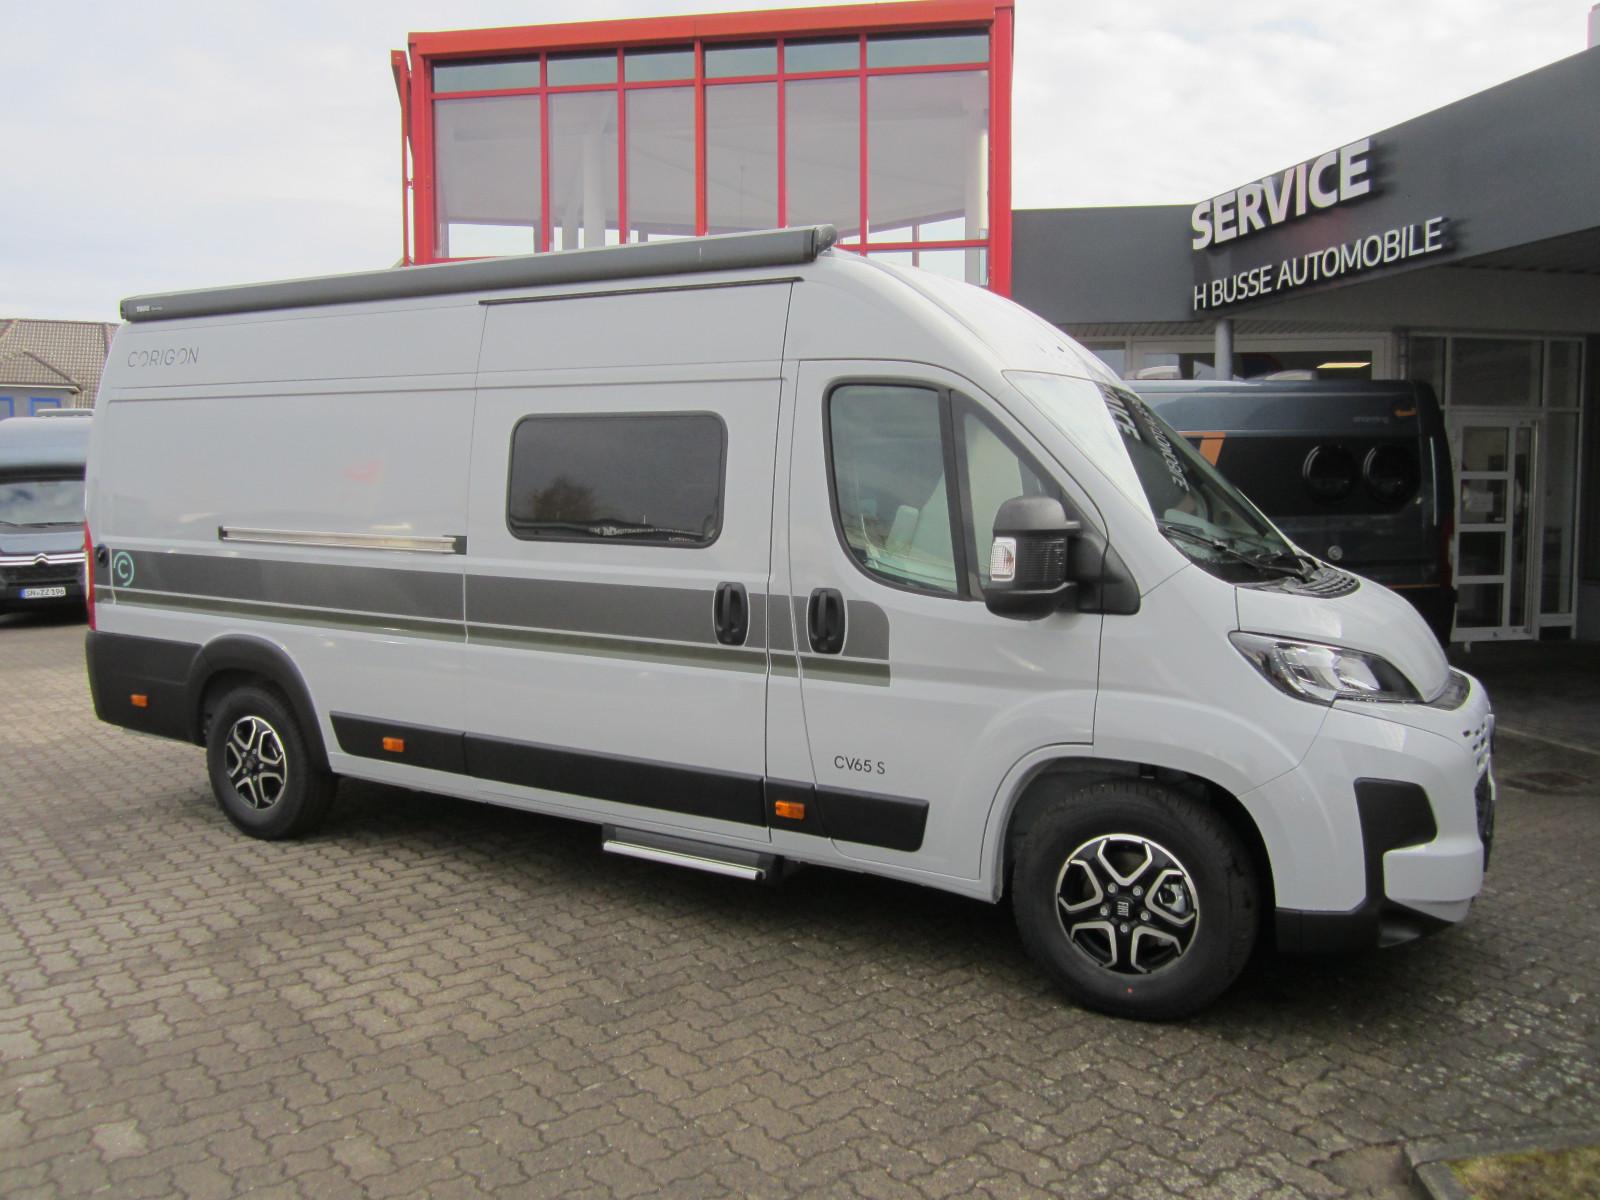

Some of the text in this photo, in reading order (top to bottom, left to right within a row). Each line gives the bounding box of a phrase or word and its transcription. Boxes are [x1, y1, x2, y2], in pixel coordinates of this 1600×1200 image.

[1192, 138, 1370, 250] SERVICE
[1193, 217, 1443, 311] H BUSSE AUTOMOBILE
[127, 346, 200, 368] CORIGON
[834, 755, 886, 775] CV65 S
[1117, 901, 1129, 917] FIAT
